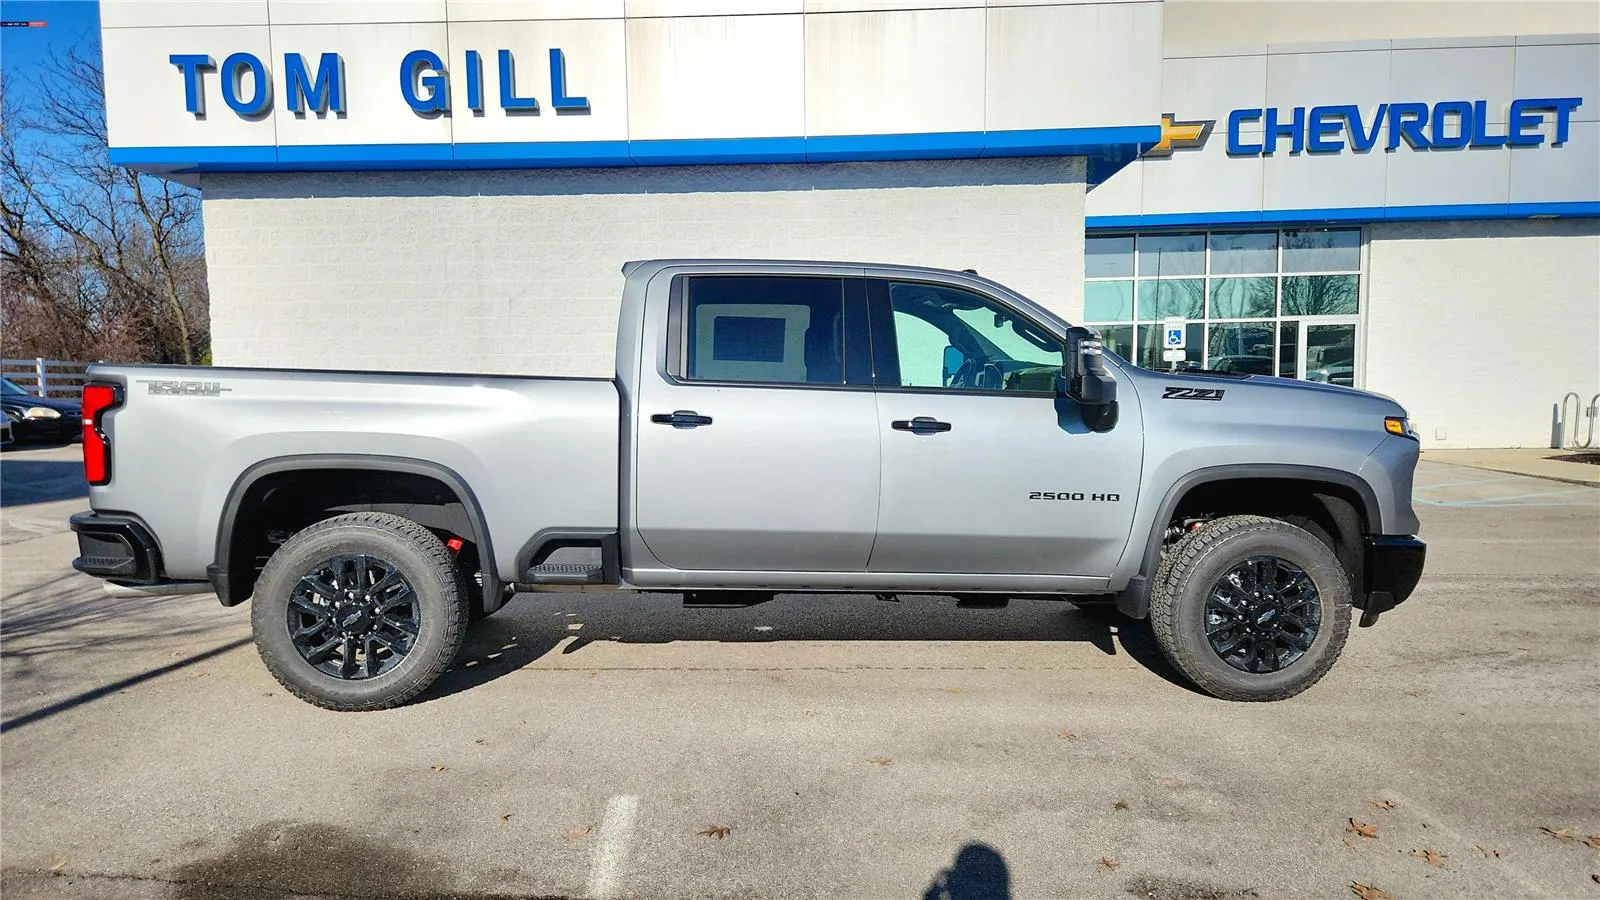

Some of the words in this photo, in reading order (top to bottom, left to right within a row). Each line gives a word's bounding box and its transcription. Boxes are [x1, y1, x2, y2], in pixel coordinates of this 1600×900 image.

[169, 52, 346, 118] TOM
[399, 48, 589, 116] GILL
[1226, 97, 1583, 157] CHEVROLET
[1028, 491, 1085, 501] 2500
[1091, 493, 1120, 502] HD
